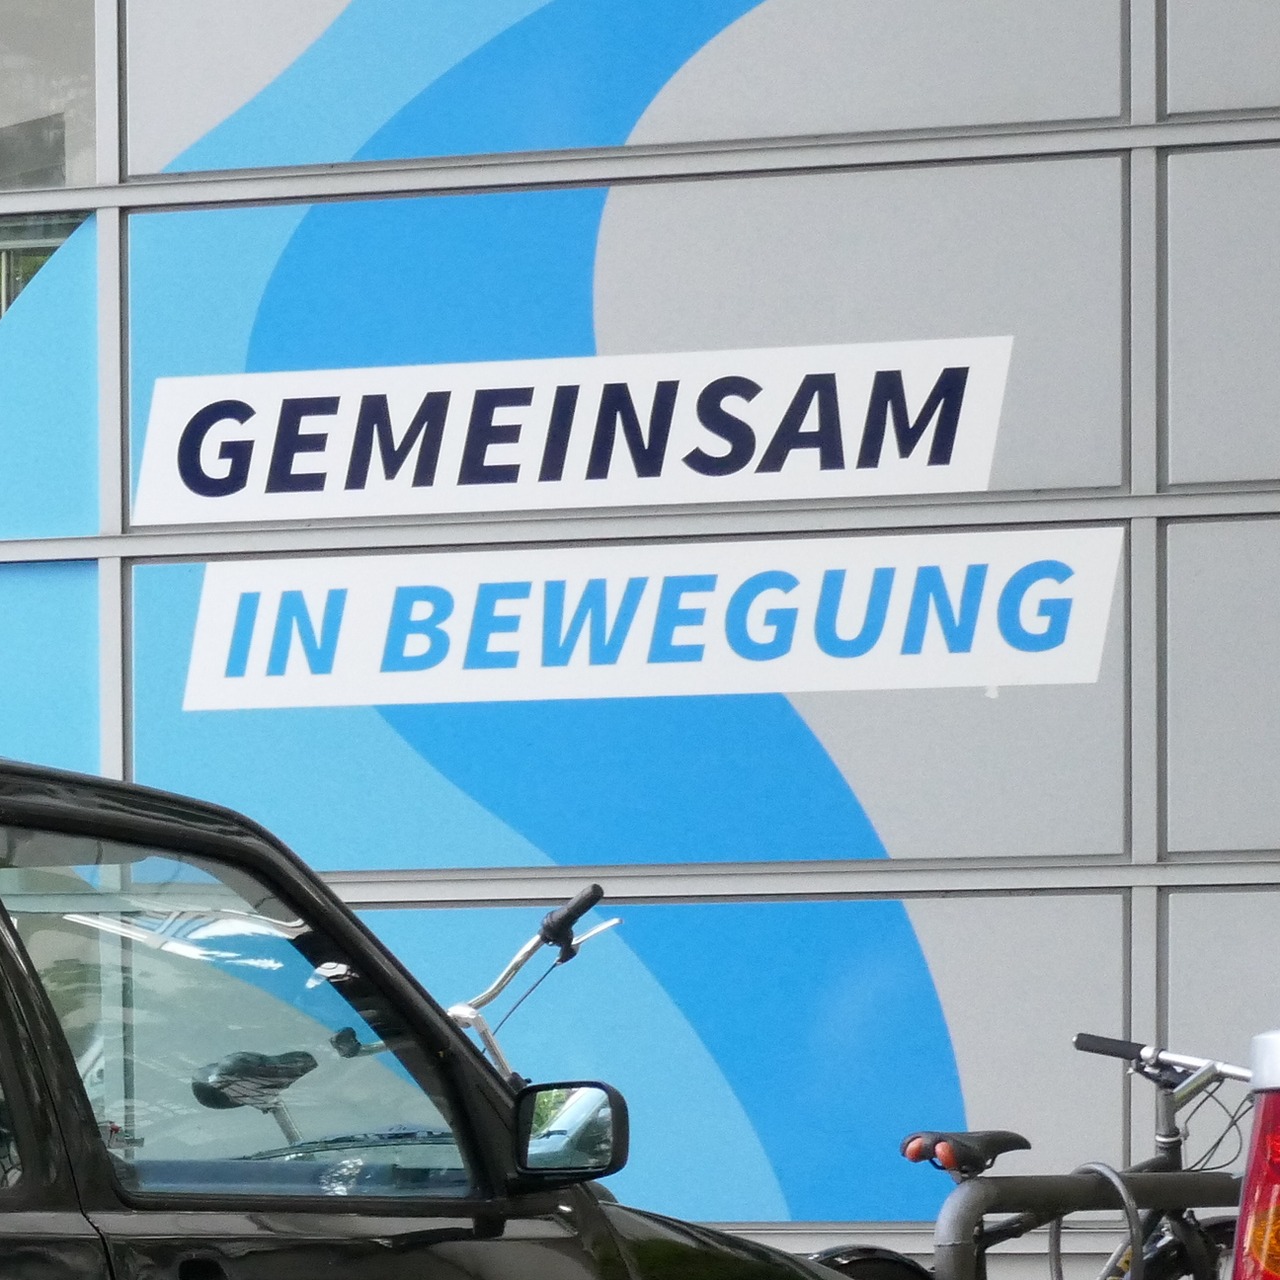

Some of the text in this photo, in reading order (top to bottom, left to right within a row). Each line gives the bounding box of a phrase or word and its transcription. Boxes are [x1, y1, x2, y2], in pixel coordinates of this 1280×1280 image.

[176, 365, 971, 499] GEMEINSAM
[224, 558, 1075, 679] IN BEWEGUNG
